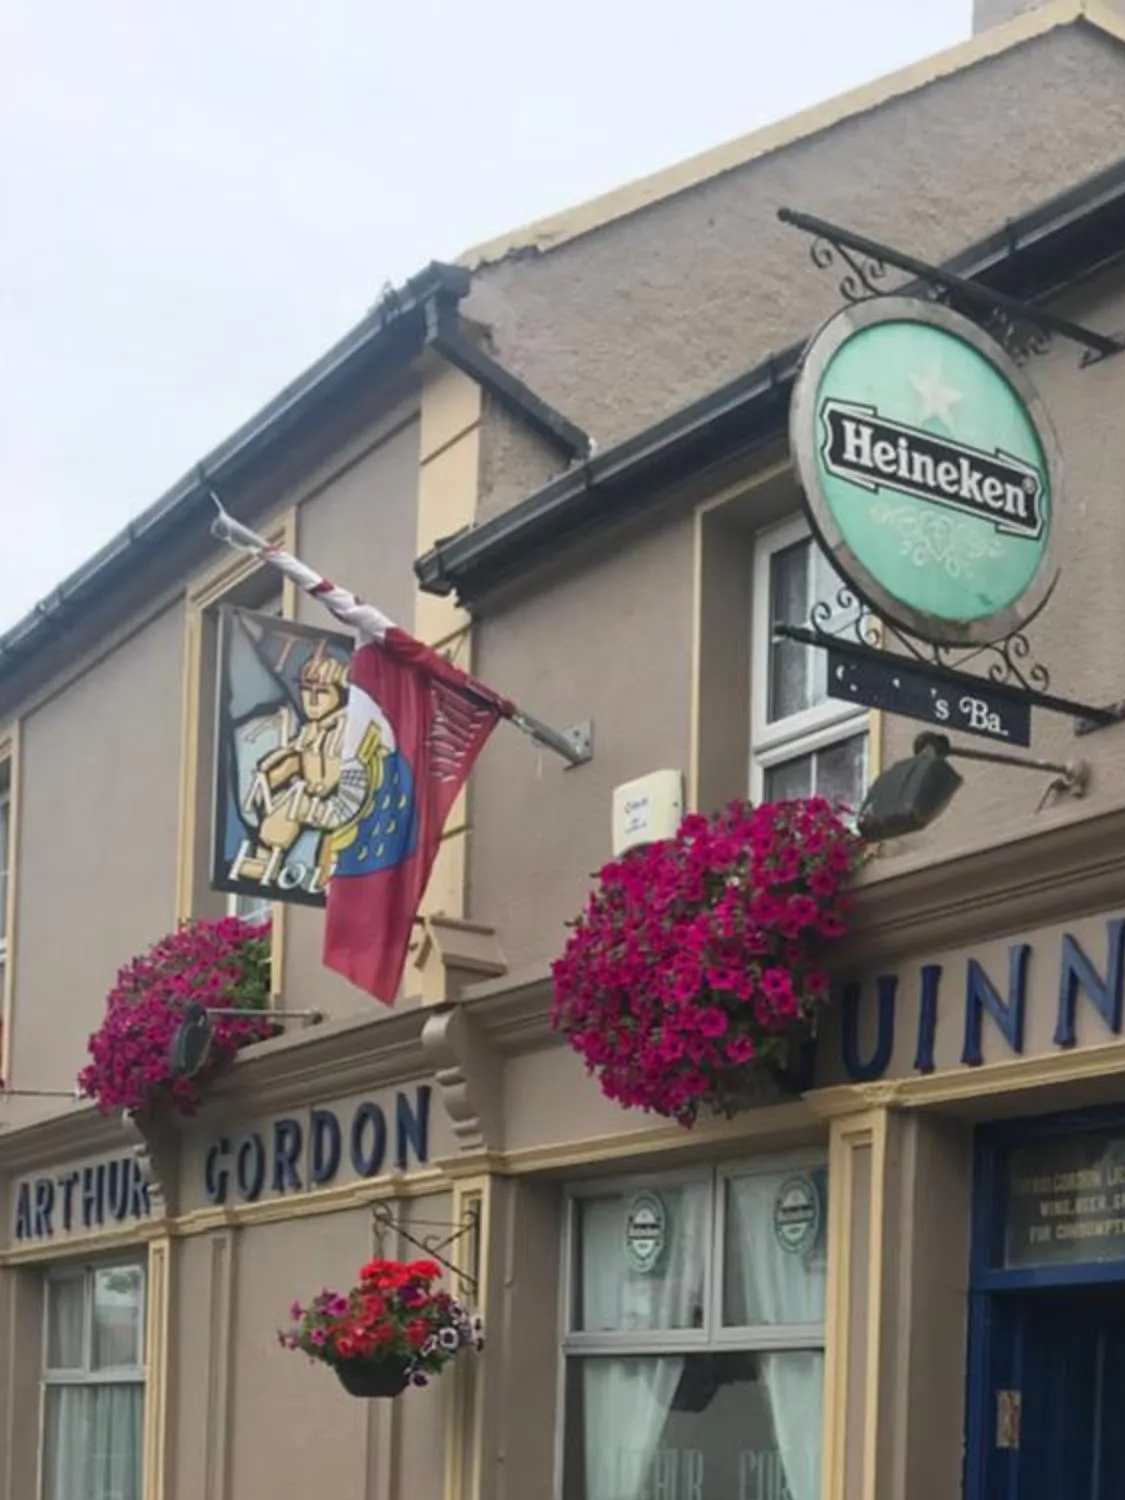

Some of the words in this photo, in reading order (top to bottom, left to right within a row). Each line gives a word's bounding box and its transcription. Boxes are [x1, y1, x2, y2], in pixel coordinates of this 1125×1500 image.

[842, 419, 1027, 517] Heineken
[959, 696, 1009, 736] Ba
[205, 1085, 431, 1205] GORDON
